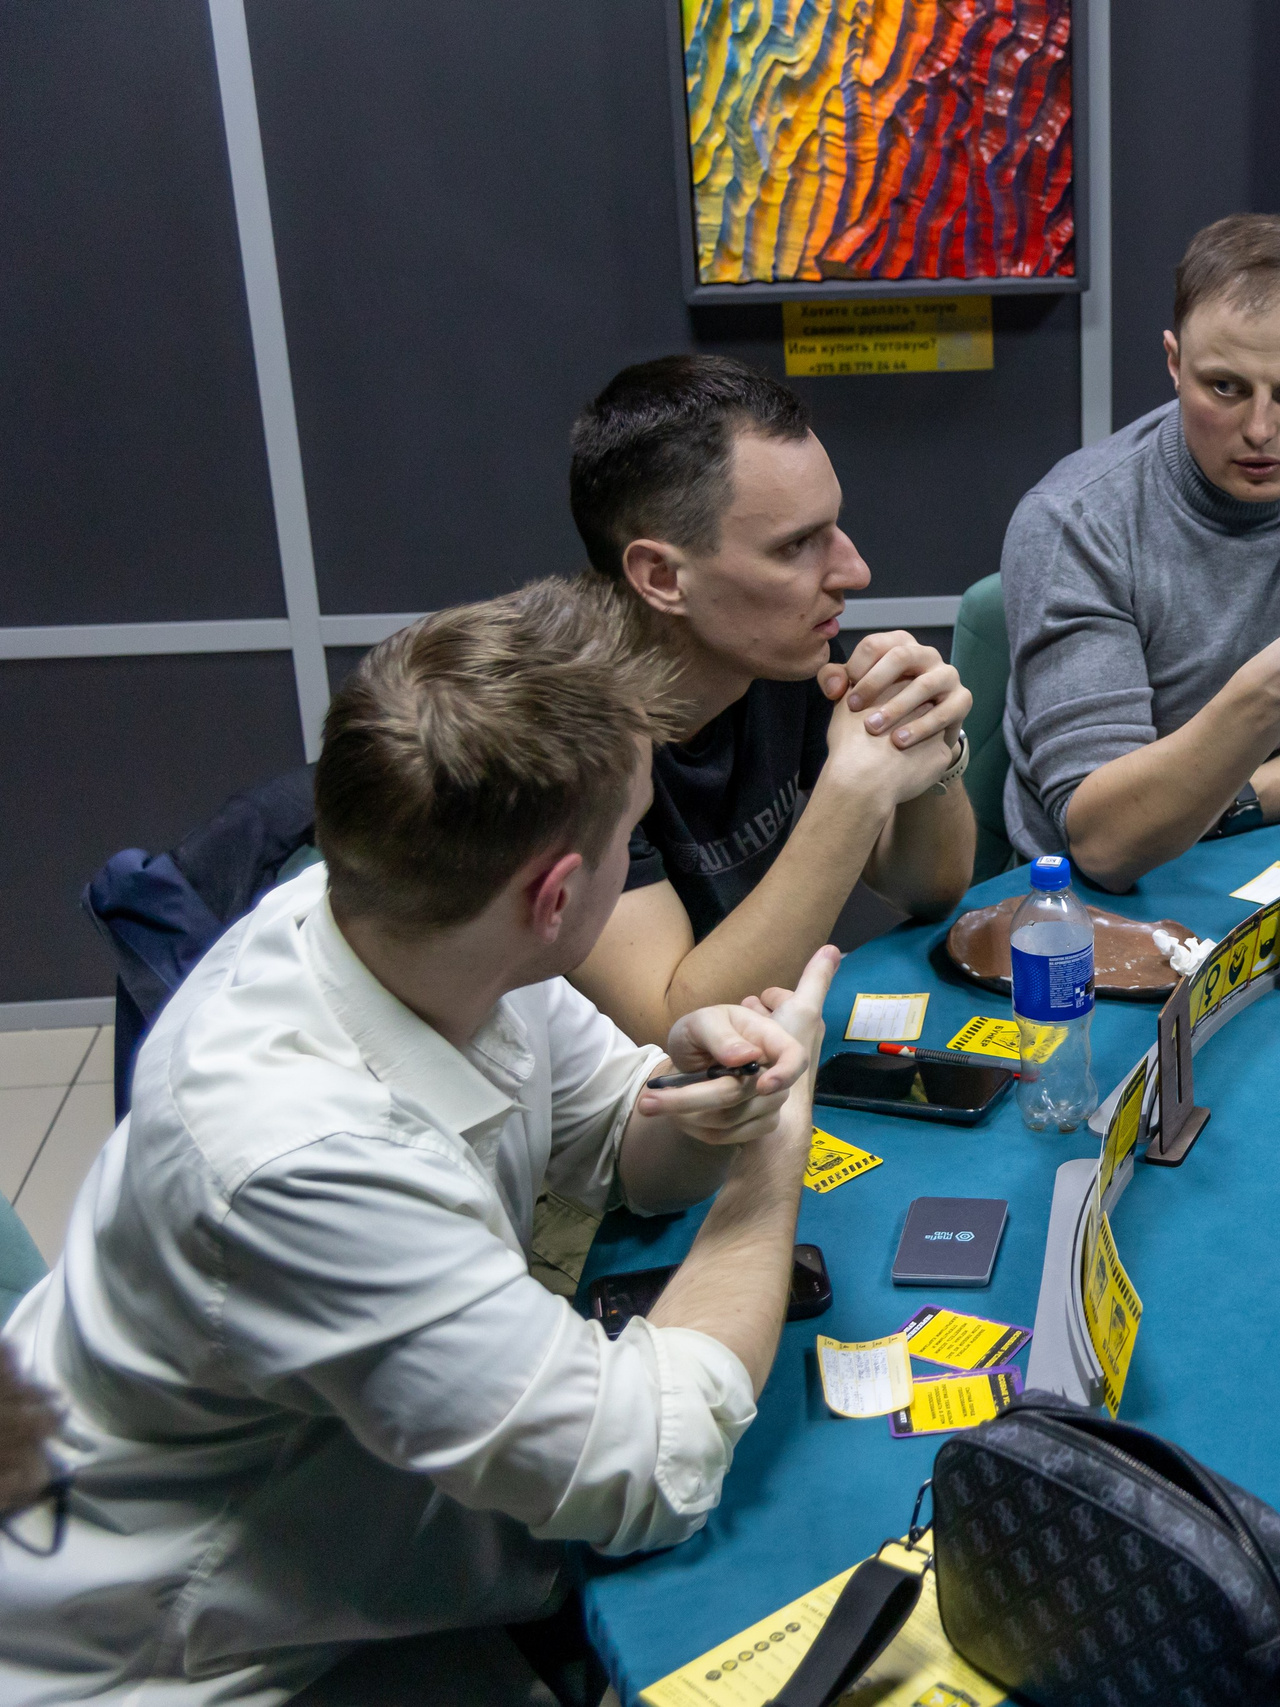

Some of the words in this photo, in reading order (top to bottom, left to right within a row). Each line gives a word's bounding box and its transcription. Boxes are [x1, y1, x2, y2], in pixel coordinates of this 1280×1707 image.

[801, 305, 848, 317] Хотите
[853, 304, 909, 316] сделать
[788, 342, 816, 354] Или
[980, 1025, 1004, 1047] БУНКЕР
